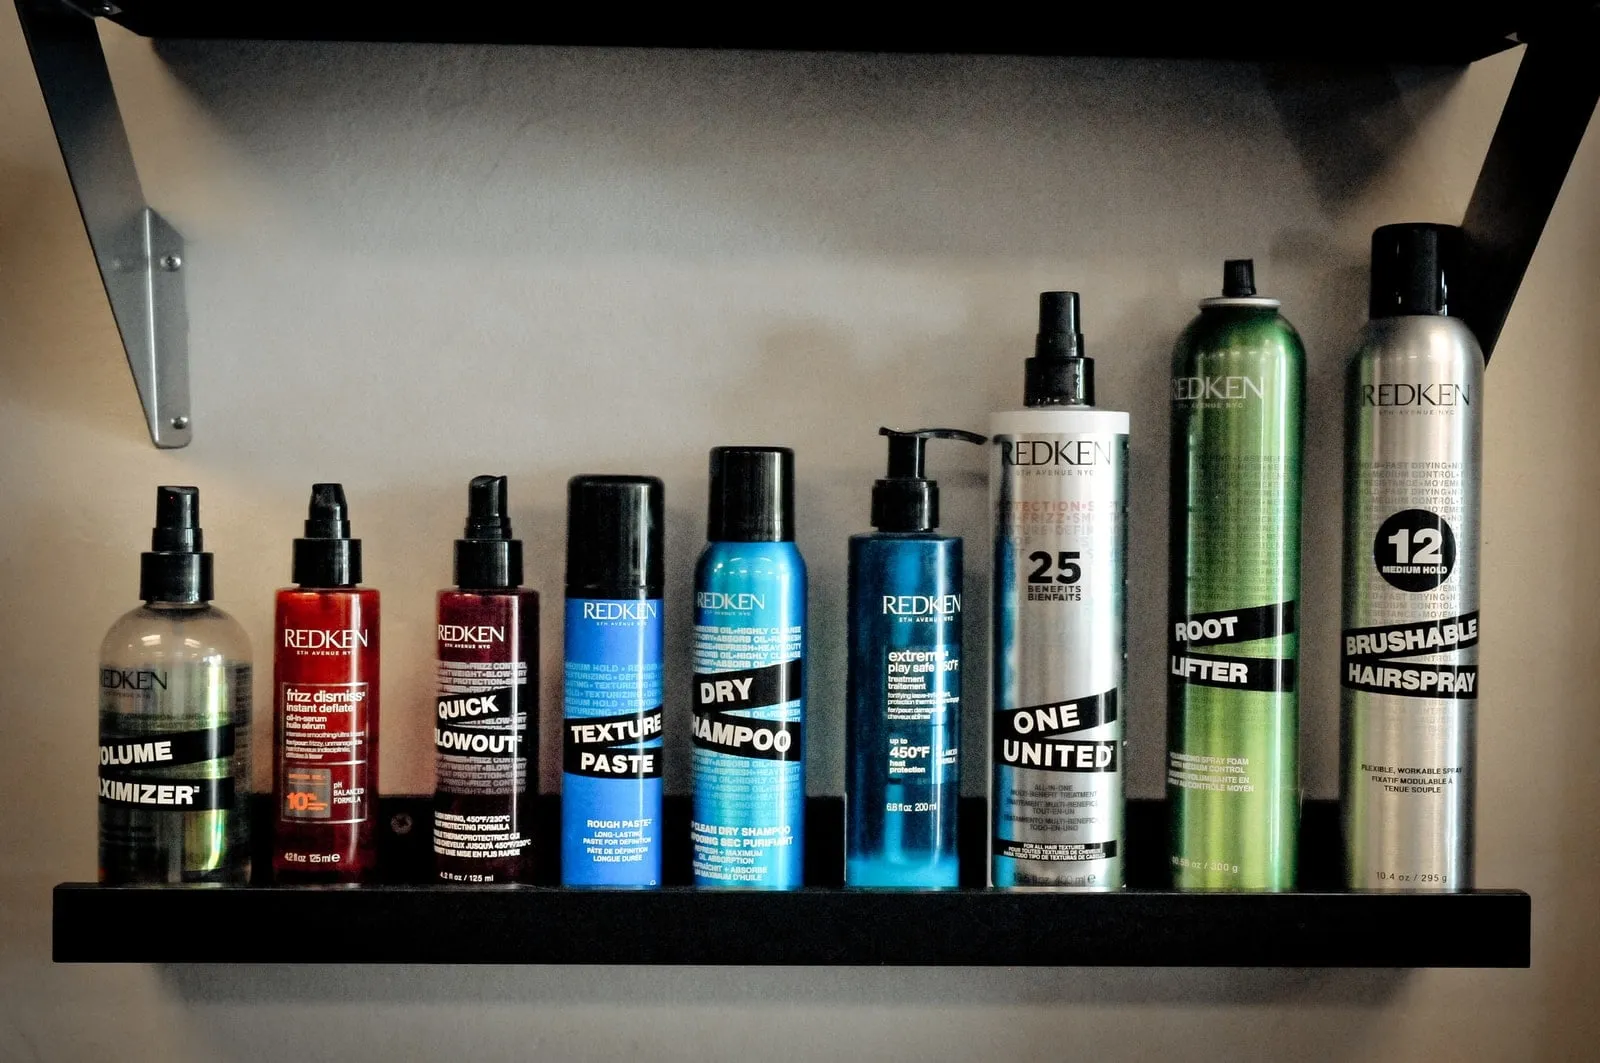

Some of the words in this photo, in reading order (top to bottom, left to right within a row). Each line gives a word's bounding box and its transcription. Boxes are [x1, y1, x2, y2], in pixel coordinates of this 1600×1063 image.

[1170, 376, 1264, 400] REDKEN
[1361, 384, 1470, 407] REDKEN
[1001, 440, 1111, 466] REDKEN
[1388, 528, 1443, 564] 12
[1028, 550, 1081, 585] 25
[1382, 565, 1420, 574] MEDIUM
[1422, 565, 1448, 574] HOLD
[1028, 585, 1081, 593] BENEFITS
[697, 592, 765, 610] REDKEN
[1028, 593, 1081, 601] BIENFAITS
[584, 602, 657, 620] REDKEN
[883, 594, 961, 615] REDKEN
[438, 624, 504, 642] REDKEN
[1175, 616, 1238, 642] ROOT
[284, 628, 368, 649] REDKEN
[1346, 618, 1477, 656] BRUSHABLE
[888, 662, 911, 675] play
[913, 662, 934, 673] safe
[1171, 655, 1248, 683] LIFTER
[101, 668, 168, 690] EDKEN
[1349, 662, 1475, 692] HAIRSPRAY
[286, 688, 312, 702] frizz
[700, 677, 753, 704] DRY
[287, 703, 317, 712] instant
[319, 703, 355, 713] deflate
[439, 695, 500, 720] QUICK
[1013, 703, 1080, 734] ONE
[571, 713, 662, 743] TEXTURE
[435, 728, 518, 753] LOWOUT
[98, 741, 173, 765] OLUME
[890, 746, 930, 759] 450°F
[1003, 738, 1112, 768] UNITED
[581, 752, 654, 773] PASTE
[890, 759, 906, 767] heat
[1226, 758, 1250, 766] FOAM
[1361, 763, 1396, 775] FLEXIBLE,
[1398, 767, 1441, 775] WORKABLE
[890, 767, 926, 775] protection
[1239, 776, 1249, 784] EN
[1371, 776, 1399, 784] FIXATIF
[1400, 776, 1446, 785] MODULABLE
[1227, 784, 1255, 792] MOYEN
[1384, 785, 1409, 793] TENUE
[1411, 786, 1442, 794] SOUPLE
[333, 796, 362, 804] FORMULA
[904, 804, 912, 812] oz
[915, 803, 929, 812] 200
[587, 820, 620, 829] ROUGH
[719, 826, 739, 836] DRY
[583, 837, 603, 845] PASTE
[604, 838, 618, 846] FOR
[593, 854, 620, 862] LONGUE
[1192, 860, 1201, 869] oz
[1232, 864, 1238, 874] g
[470, 874, 483, 882] 125
[485, 874, 494, 882] ml
[1376, 871, 1395, 881] 10.4
[1398, 874, 1410, 882] oz
[1421, 874, 1440, 882] 295
[1442, 874, 1448, 884] g
